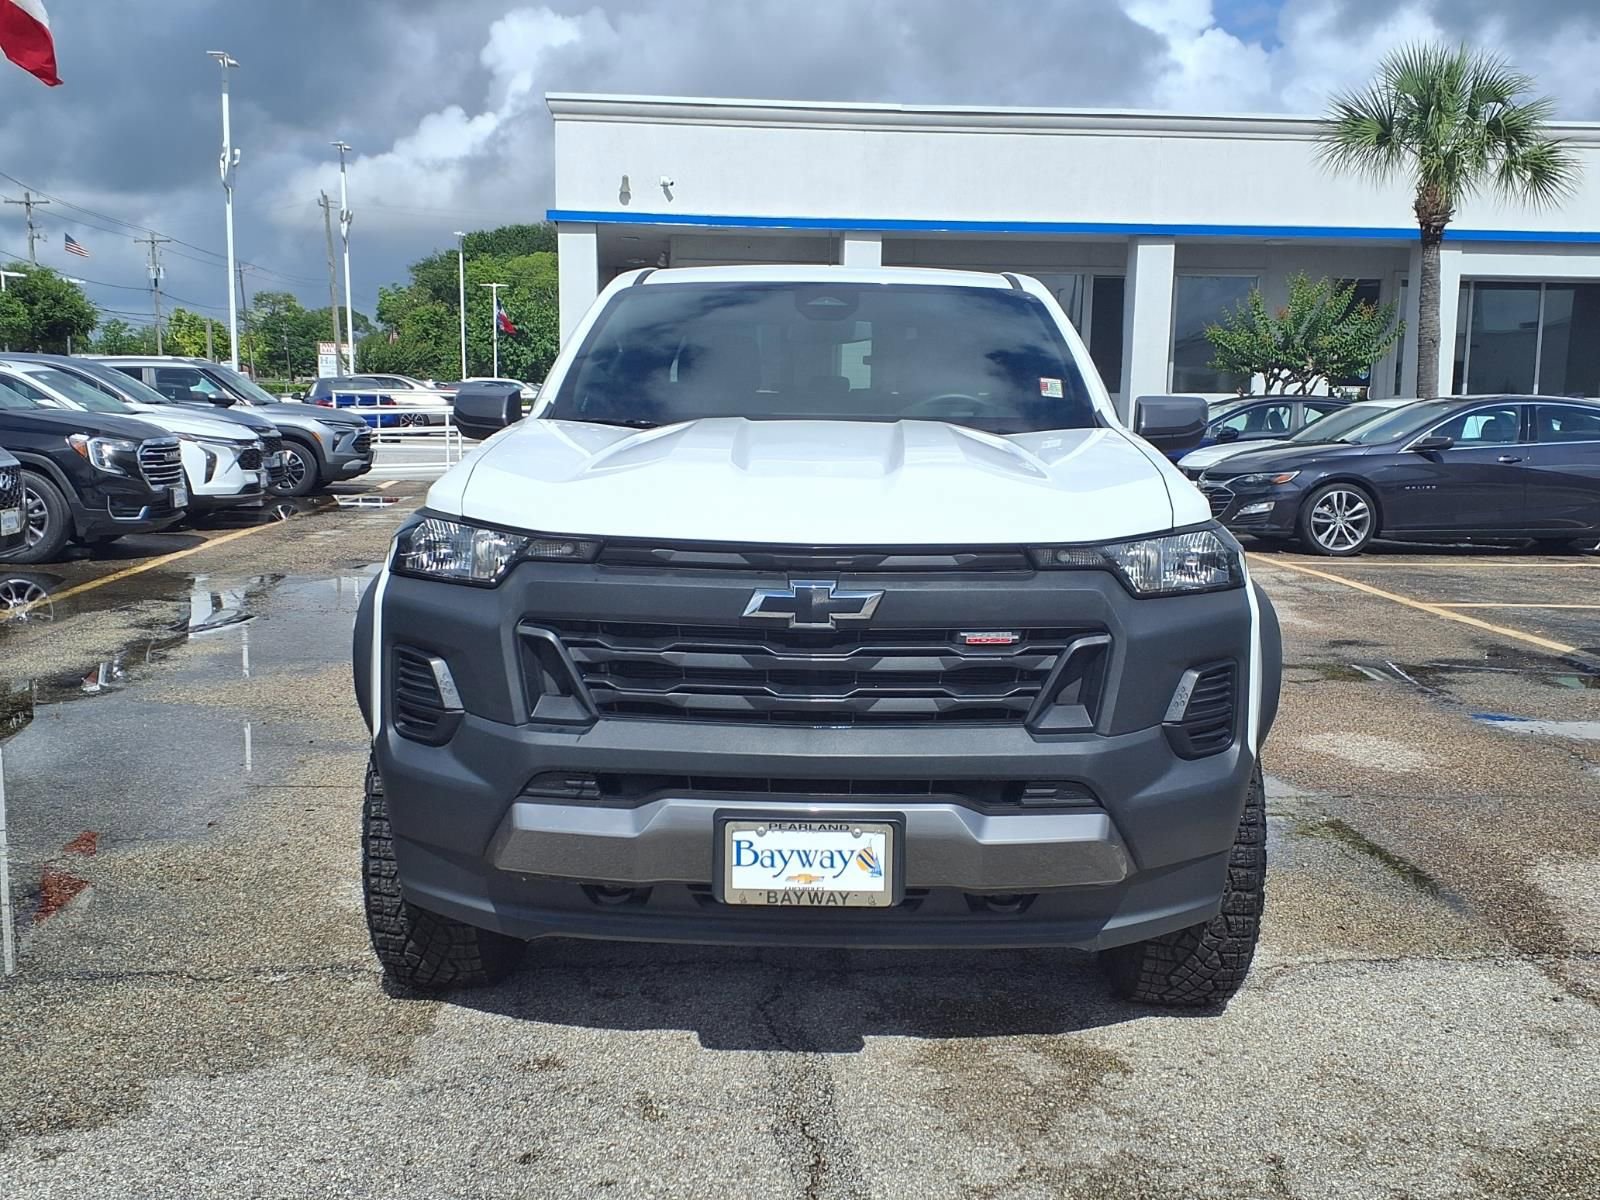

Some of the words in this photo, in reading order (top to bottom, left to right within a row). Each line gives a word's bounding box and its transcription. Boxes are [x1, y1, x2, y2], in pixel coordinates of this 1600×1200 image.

[768, 822, 850, 831] PEARLAND
[733, 839, 857, 879] Bayway
[766, 891, 850, 906] BAYWAY
